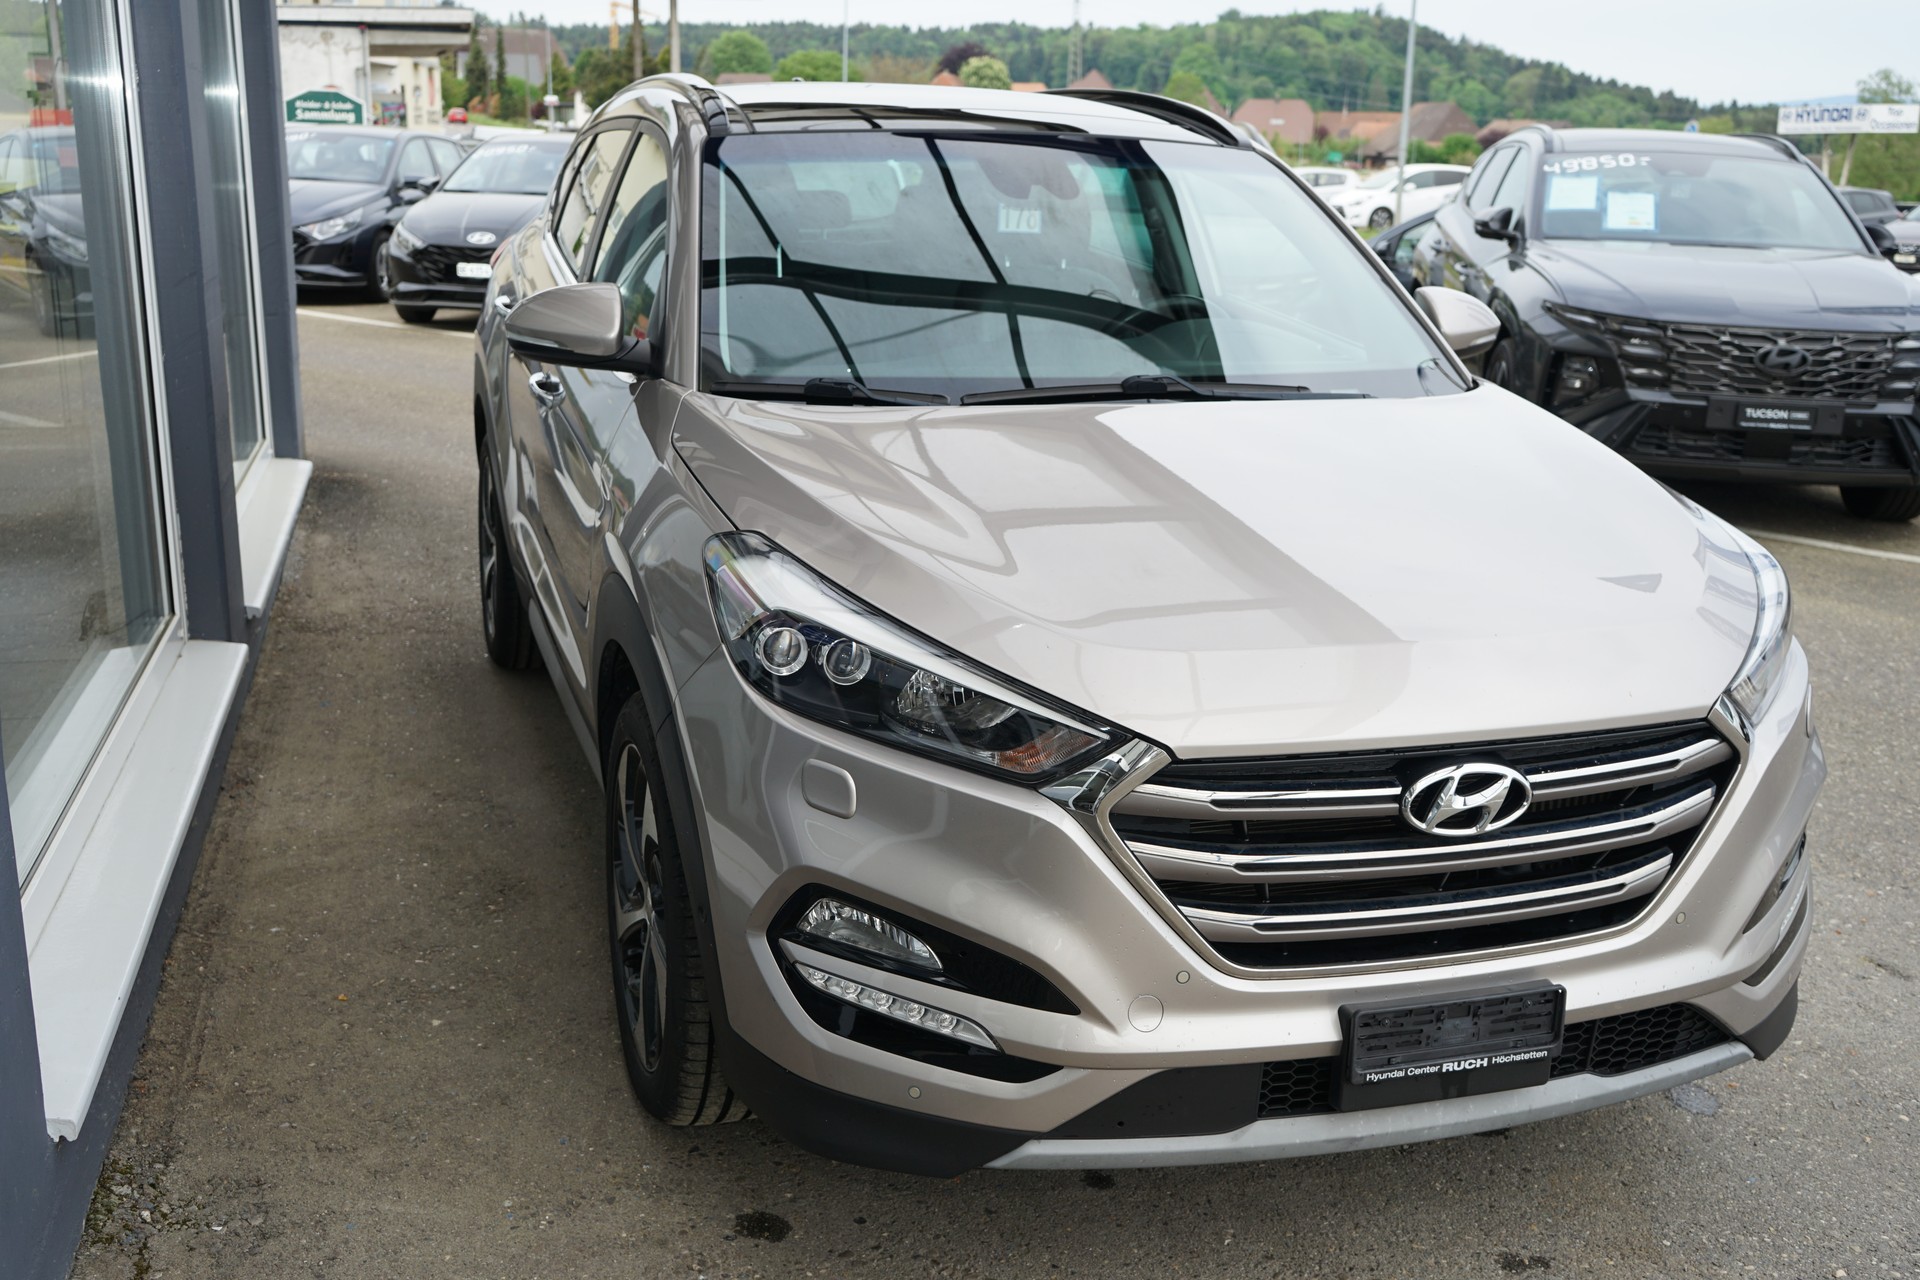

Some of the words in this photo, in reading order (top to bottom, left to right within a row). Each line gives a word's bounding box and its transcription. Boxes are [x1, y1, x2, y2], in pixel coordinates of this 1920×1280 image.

[295, 108, 355, 124] Sammlung
[1795, 108, 1852, 122] HYUNDAI
[1745, 407, 1789, 420] TUCSON
[1366, 1068, 1405, 1082] Hyundai
[1407, 1065, 1440, 1076] Center
[1442, 1057, 1489, 1073] RUCH
[1491, 1050, 1548, 1065] Höchstetten
